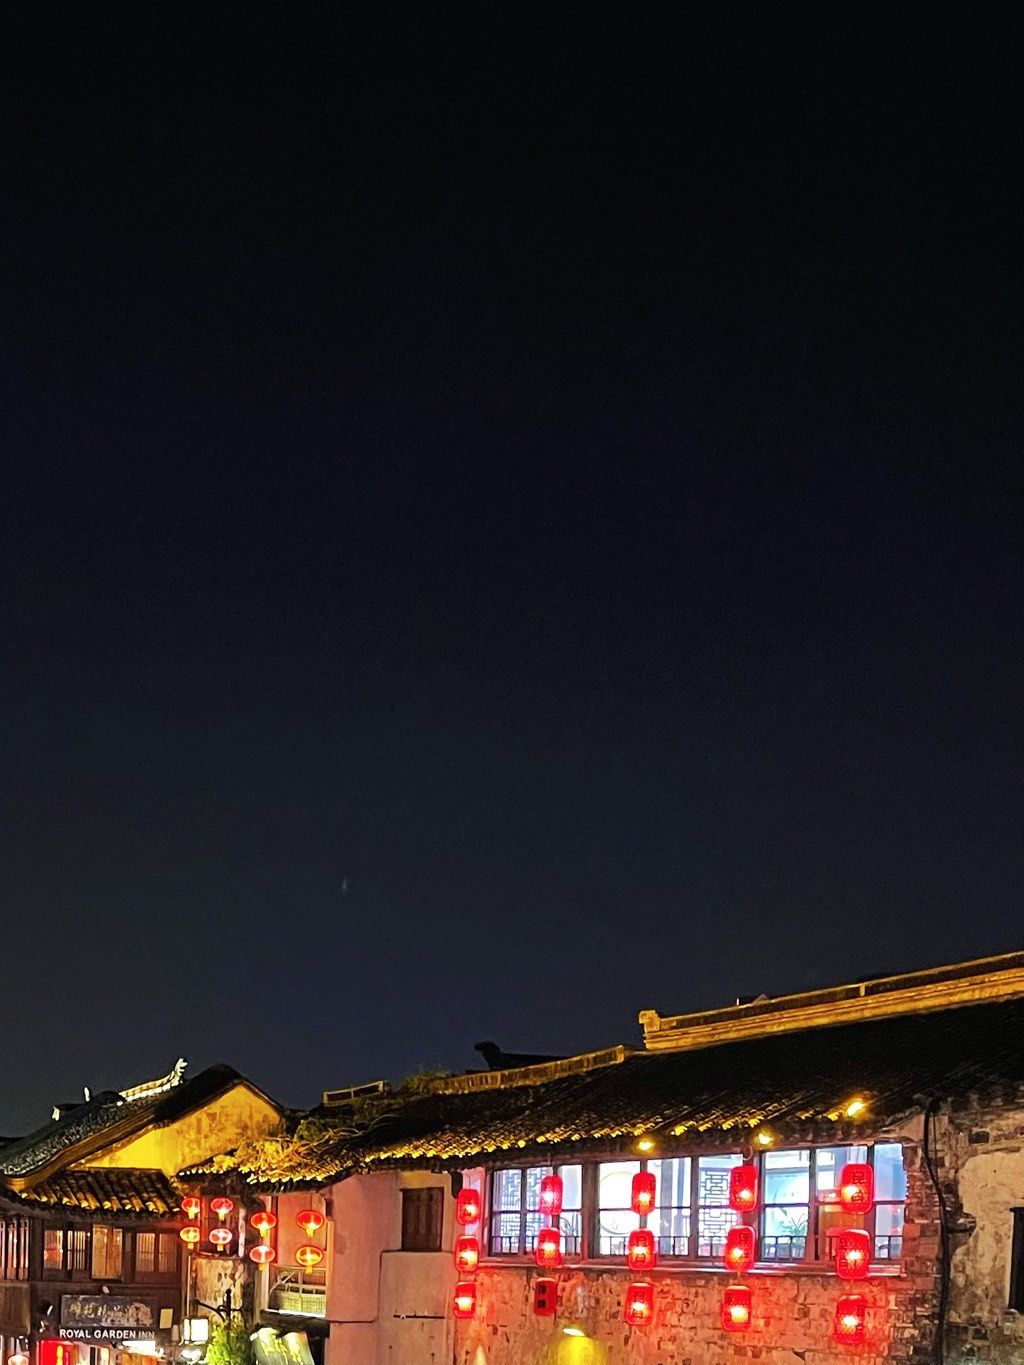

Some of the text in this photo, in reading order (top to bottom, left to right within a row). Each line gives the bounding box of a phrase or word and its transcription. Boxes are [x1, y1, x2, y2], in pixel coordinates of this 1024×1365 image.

[59, 1328, 155, 1339] ROYAL GARDEN INN
